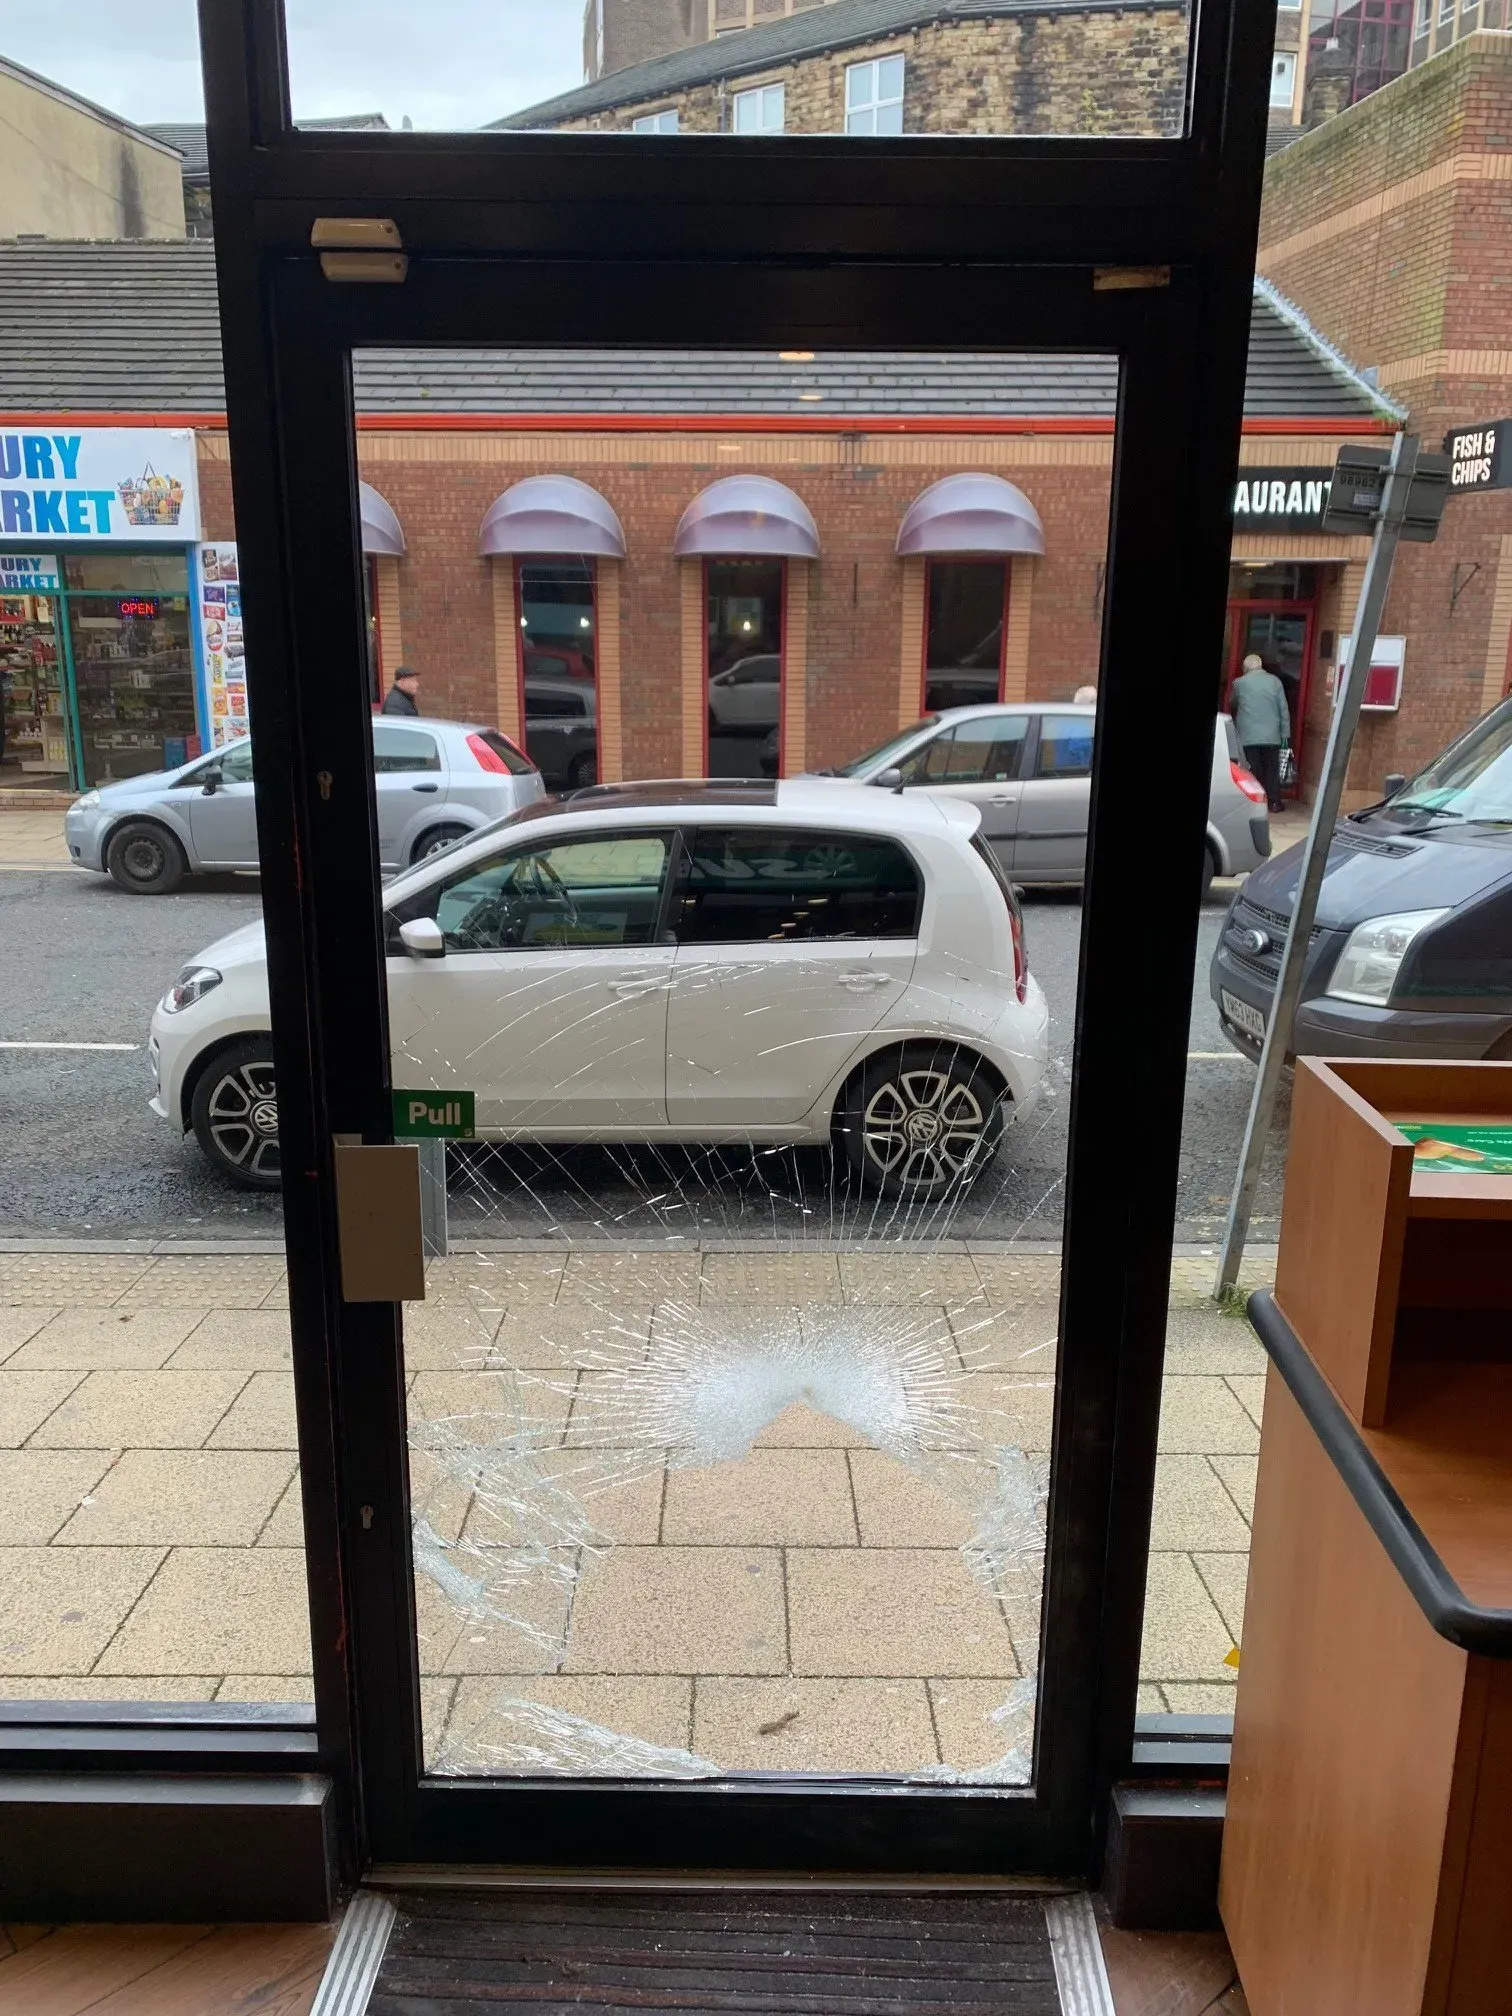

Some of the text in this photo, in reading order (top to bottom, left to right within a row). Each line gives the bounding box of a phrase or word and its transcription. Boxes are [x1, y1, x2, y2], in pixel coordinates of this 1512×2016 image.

[1452, 430, 1496, 460] FISH &
[1451, 457, 1492, 486] CHIPS
[0, 490, 116, 533] RKET
[121, 603, 154, 614] OPEN
[409, 1102, 461, 1125] Pull
